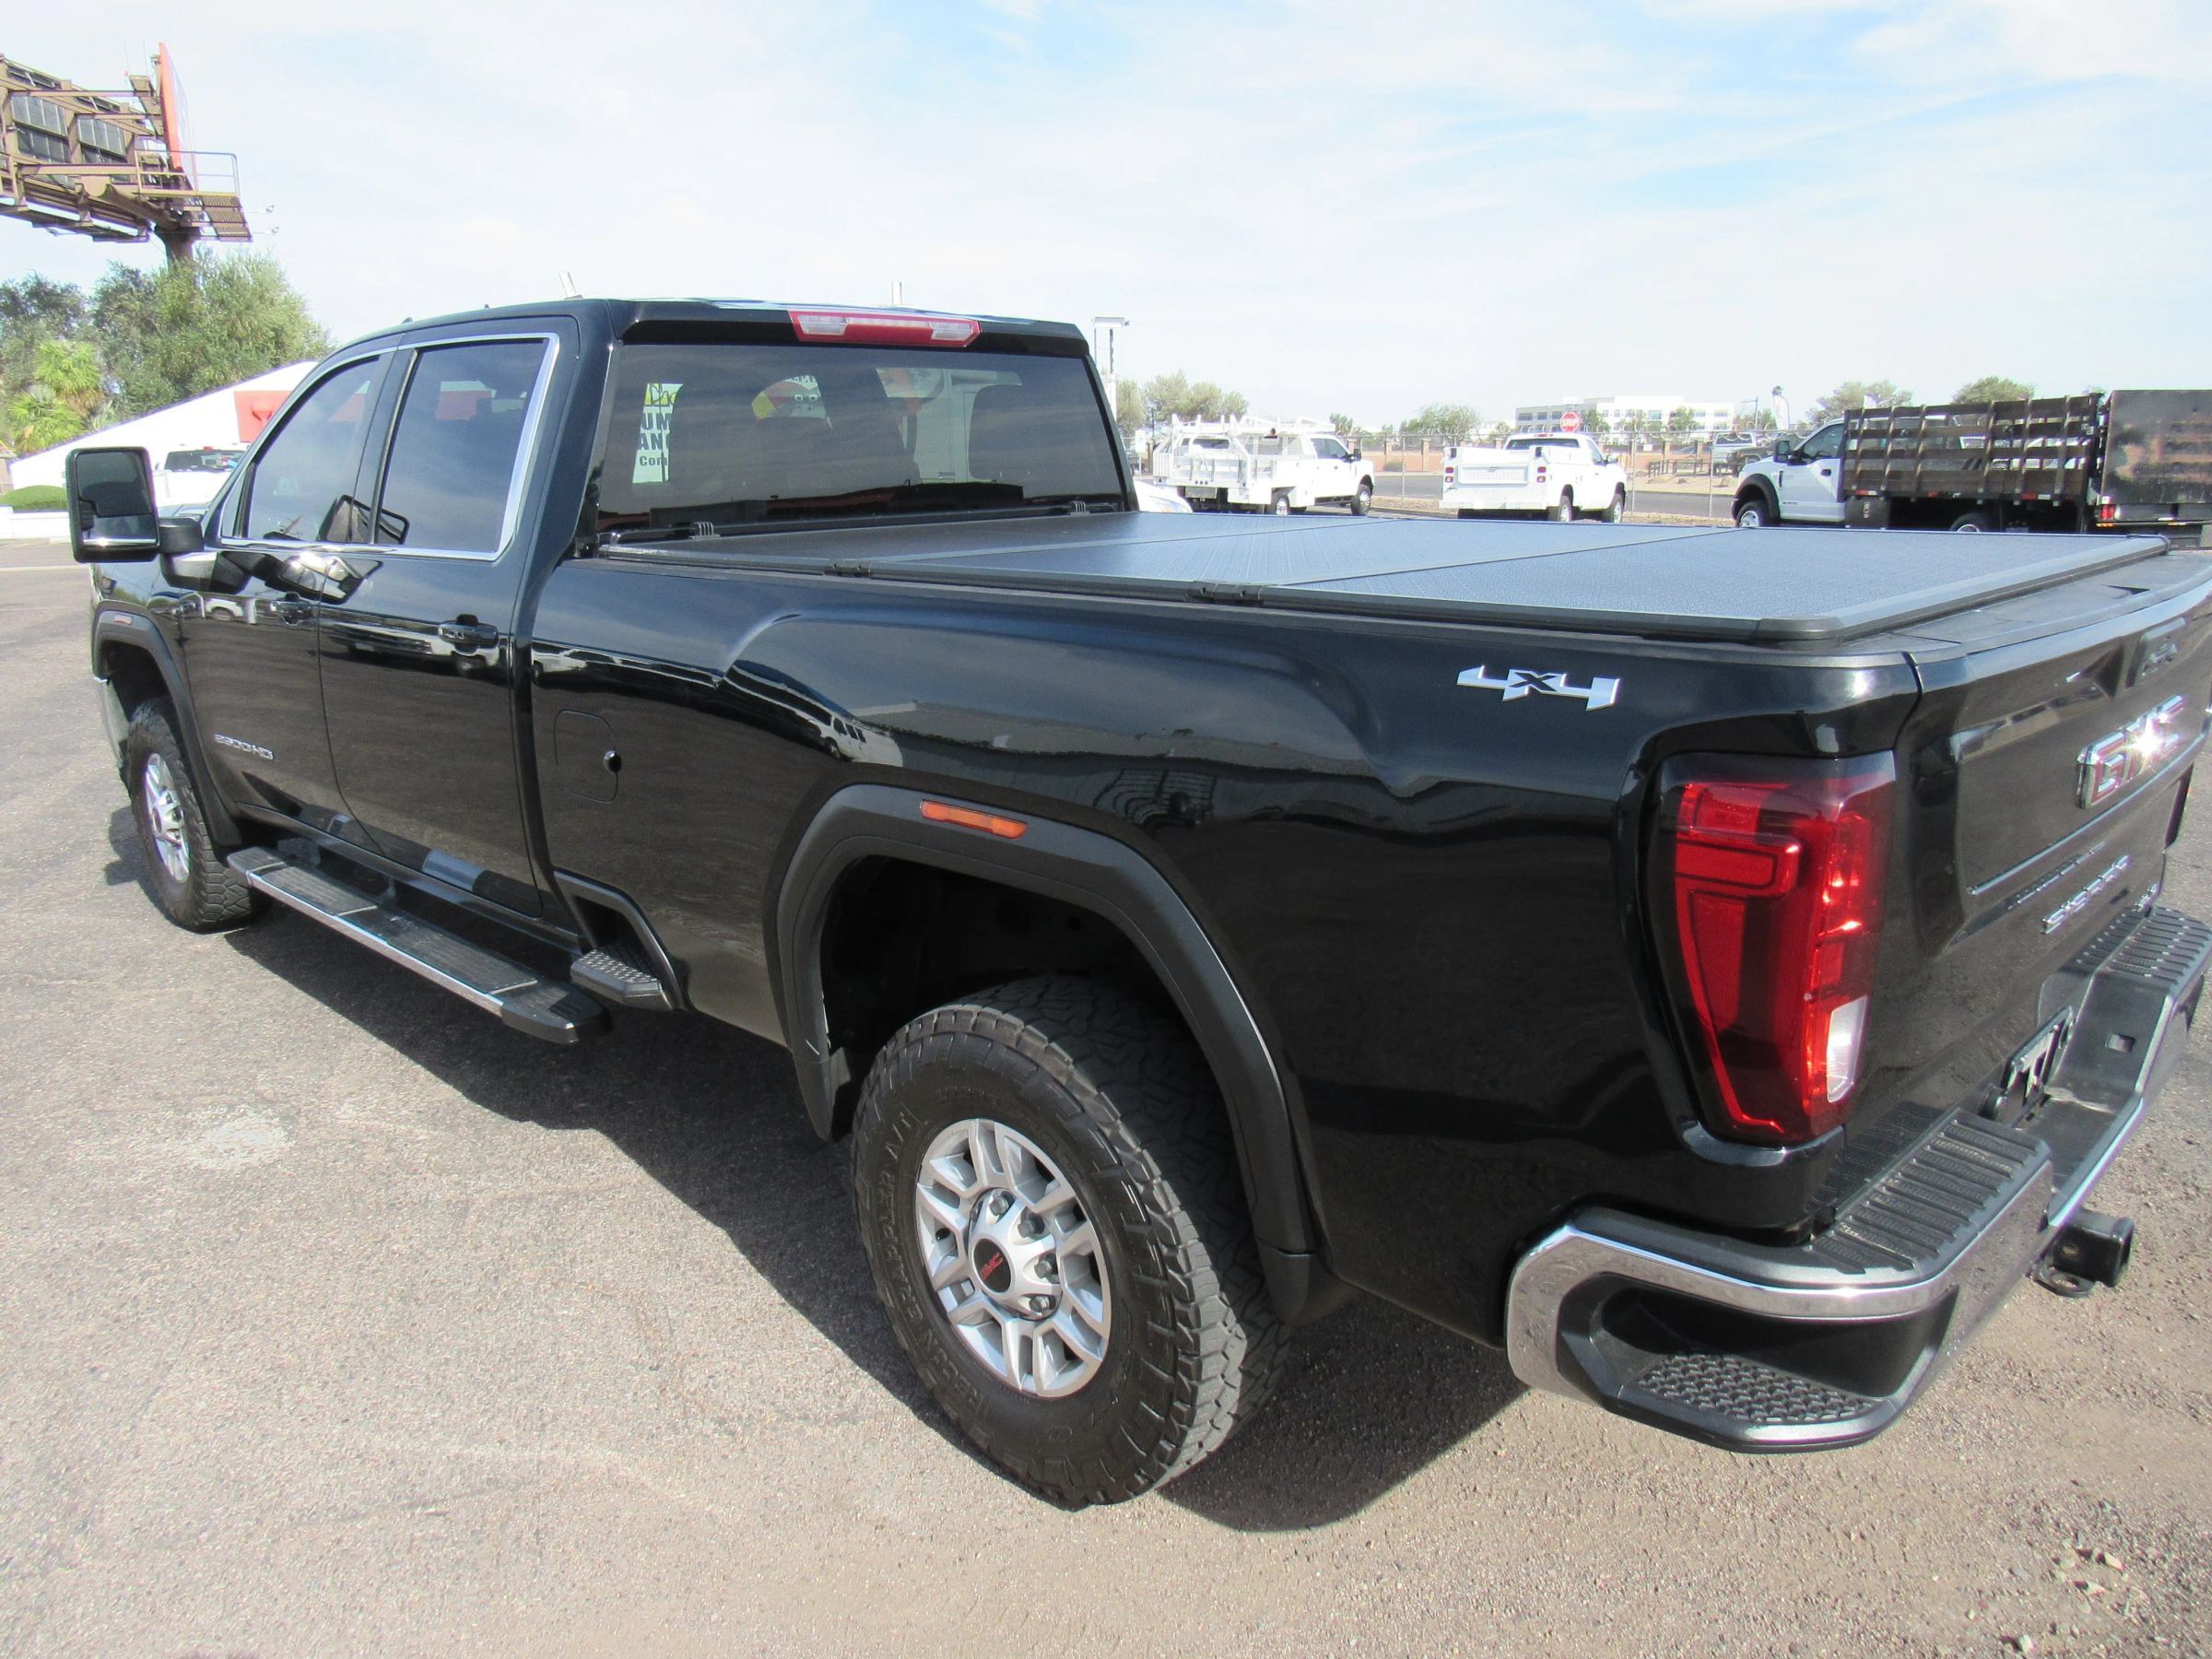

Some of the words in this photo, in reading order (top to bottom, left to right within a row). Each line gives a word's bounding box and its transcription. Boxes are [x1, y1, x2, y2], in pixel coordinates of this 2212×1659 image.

[1562, 418, 1578, 427] STOP
[1456, 665, 1620, 712] 4X4
[2077, 694, 2184, 808] GMC
[980, 1252, 1004, 1280] GMC
